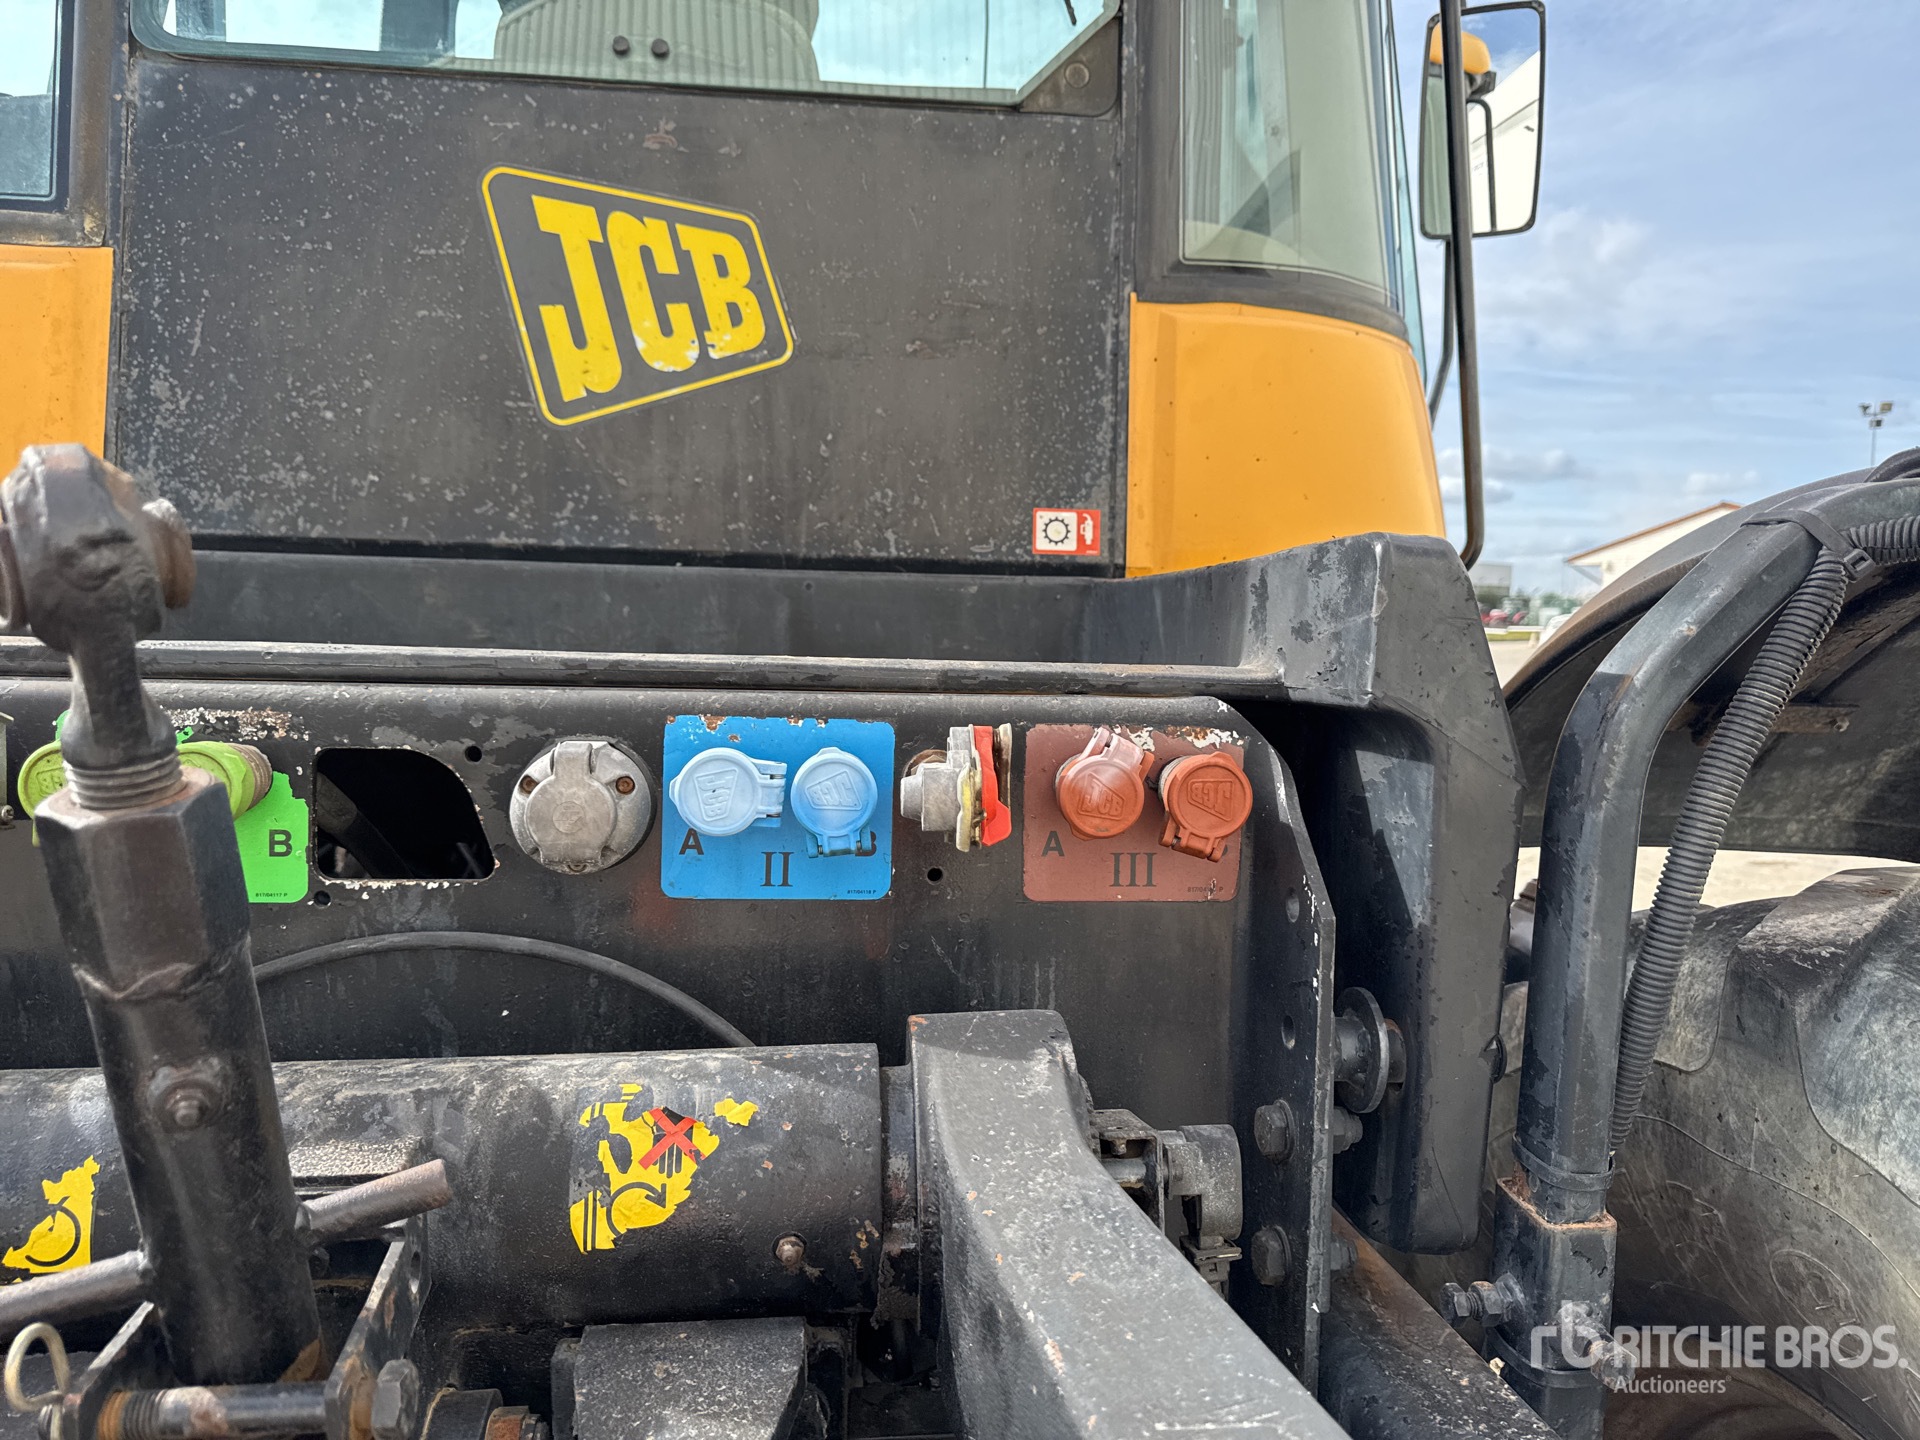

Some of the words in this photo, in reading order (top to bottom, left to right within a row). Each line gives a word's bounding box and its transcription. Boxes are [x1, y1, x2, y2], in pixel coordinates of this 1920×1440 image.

[531, 193, 766, 403] JCB
[697, 775, 734, 817] JCB
[810, 773, 859, 807] JCB
[1082, 778, 1123, 816] JCB
[1191, 782, 1232, 816] JCB
[268, 829, 293, 857] B
[678, 828, 705, 856] A
[1041, 831, 1066, 857] A
[760, 852, 795, 887] II
[1109, 852, 1158, 888] III
